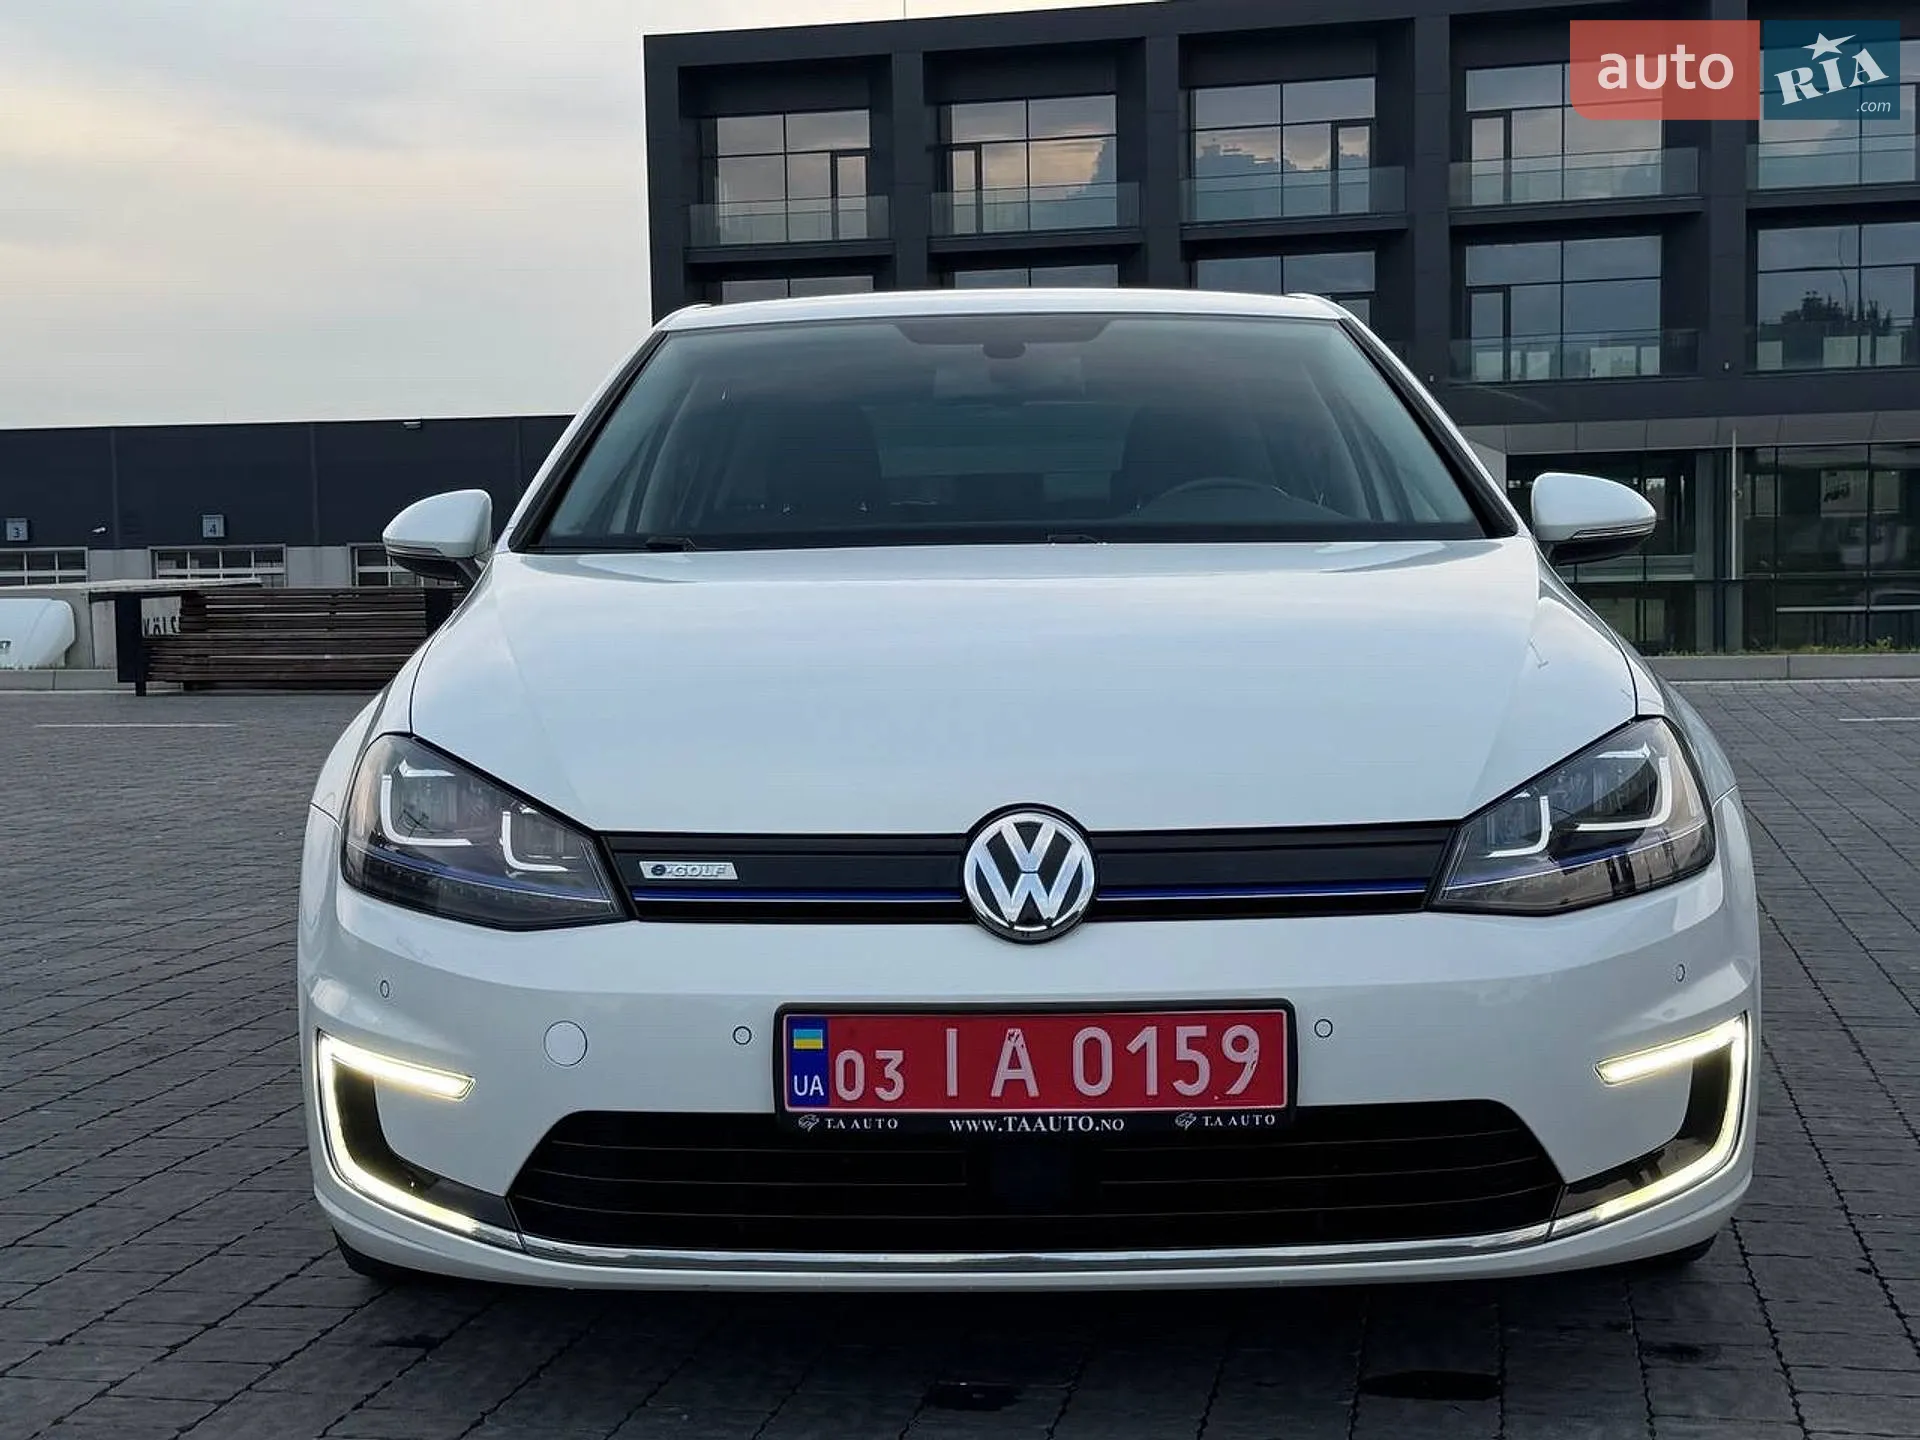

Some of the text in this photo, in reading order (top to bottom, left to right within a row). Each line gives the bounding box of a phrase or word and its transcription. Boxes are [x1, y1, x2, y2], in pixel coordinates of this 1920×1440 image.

[209, 524, 217, 535] 4
[835, 1049, 905, 1101] 03
[1072, 1024, 1261, 1097] 0159
[793, 1075, 825, 1097] UA
[850, 1117, 899, 1130] AUTO
[1228, 1114, 1276, 1126] AUTO
